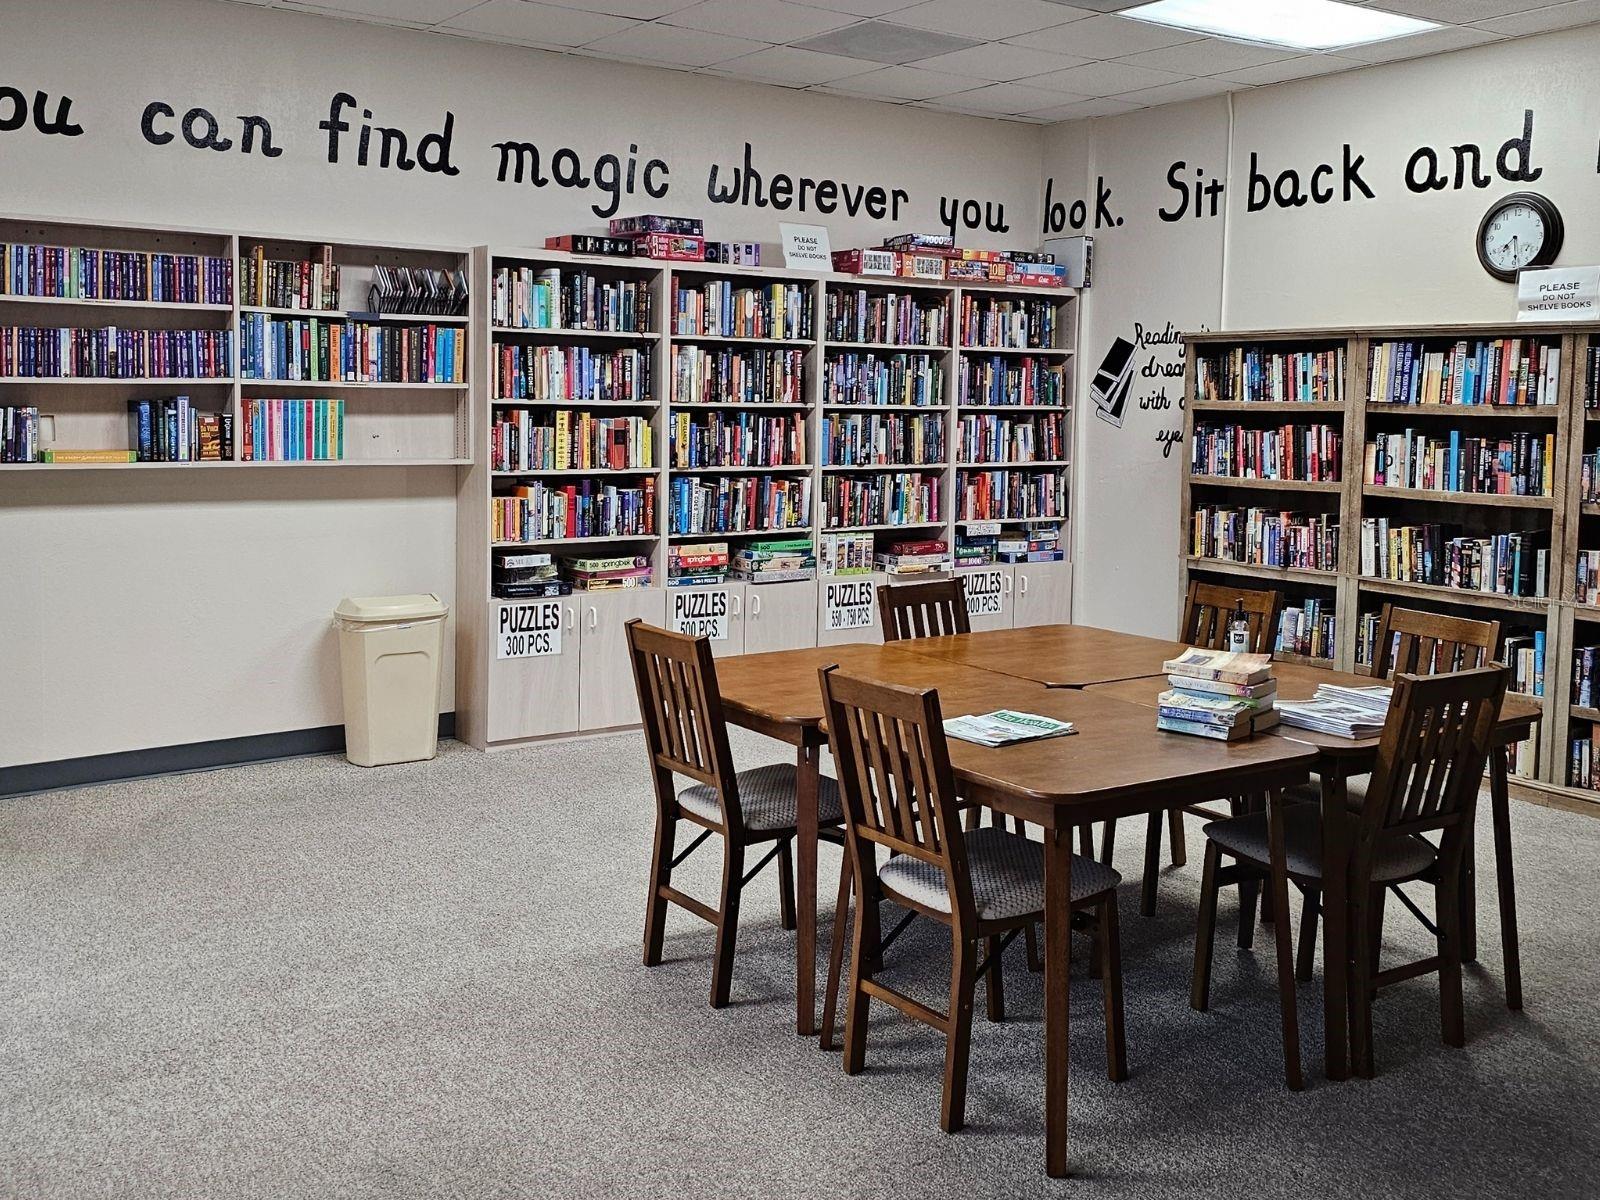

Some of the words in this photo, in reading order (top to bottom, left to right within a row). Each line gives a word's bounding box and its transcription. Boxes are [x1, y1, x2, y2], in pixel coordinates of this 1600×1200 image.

[141, 102, 283, 158] can
[319, 93, 460, 176] find
[492, 141, 670, 219] magic
[708, 143, 909, 222] wherever
[940, 196, 1009, 247] you
[1043, 177, 1124, 234] look.
[1159, 161, 1225, 222] Sit
[1248, 144, 1376, 213] back
[1405, 109, 1543, 193] and
[1502, 213, 1509, 221] 11
[1514, 208, 1522, 216] 12
[1494, 222, 1501, 231] 10
[1535, 219, 1541, 227] 2
[793, 236, 819, 245] PLEASE
[925, 235, 943, 244] 1000
[1538, 231, 1543, 239] 3
[808, 253, 827, 261] BOOKS
[1539, 282, 1581, 292] PLEASE
[1557, 292, 1576, 300] NOT
[1527, 302, 1559, 311] SHELVE
[1560, 301, 1592, 310] BOOKS
[1141, 355, 1186, 378] drea
[1528, 373, 1537, 395] REVIVAL
[1139, 386, 1171, 411] with
[1155, 429, 1184, 459] eye
[601, 558, 631, 569] springbok
[968, 557, 982, 565] 1000
[623, 577, 636, 588] 500
[962, 572, 1001, 596] PUZZLES
[828, 582, 872, 608] PUZZLES
[675, 592, 727, 620] PUZZLES
[982, 595, 1001, 613] PCS.
[500, 604, 561, 634] PUZZLES
[831, 609, 842, 627] 550
[847, 608, 857, 626] 750
[857, 608, 871, 625] PCS.
[680, 620, 697, 637] 500
[698, 619, 720, 638] PCS.
[505, 634, 526, 656] 300
[527, 632, 554, 655] PCS.
